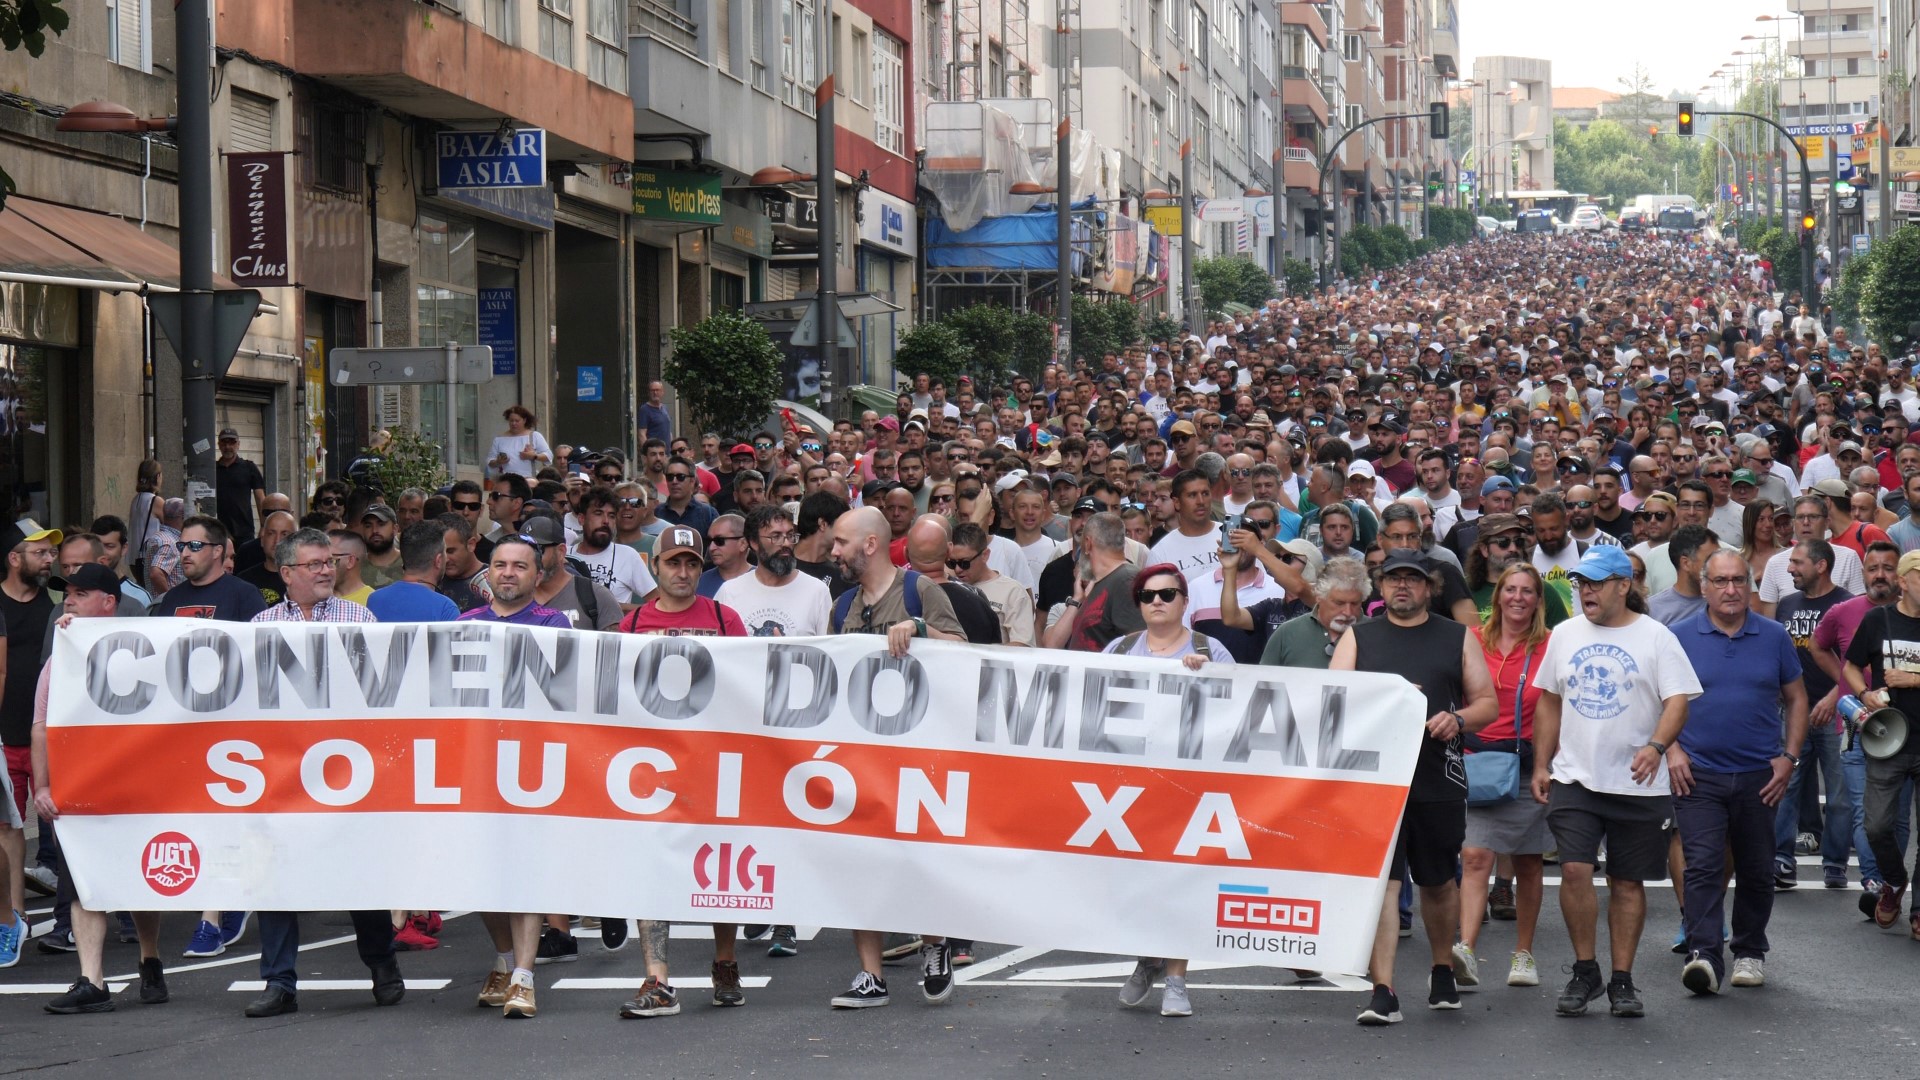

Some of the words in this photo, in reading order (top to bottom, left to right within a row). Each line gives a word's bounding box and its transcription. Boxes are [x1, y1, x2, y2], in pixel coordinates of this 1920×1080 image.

[440, 133, 539, 157] BAZAR
[456, 161, 523, 185] ASIA
[635, 172, 656, 183] prensa
[635, 186, 662, 199] locutorio
[667, 186, 695, 213] Venta
[697, 189, 721, 216] Press
[635, 201, 646, 213] fax
[232, 255, 286, 277] Chus
[480, 291, 512, 300] BAZAR
[485, 301, 507, 310] ASIA
[1548, 568, 1572, 580] CAM
[743, 607, 776, 625] OUTHERN
[1785, 620, 1819, 635] PANI
[1577, 645, 1609, 661] TRACK
[1609, 645, 1634, 669] RACE
[86, 624, 716, 720] CONVENIO
[763, 643, 930, 736] DO
[975, 658, 1380, 772] METAL
[1575, 702, 1597, 717] FLORIDA
[1599, 704, 1620, 718] MIAMI
[205, 738, 970, 838] SOLUCIÓN
[149, 842, 192, 868] UGT
[693, 842, 775, 894] CIG
[692, 895, 772, 910] INDUSTRIA
[1223, 900, 1314, 929] CCOO
[1216, 929, 1317, 956] industria
